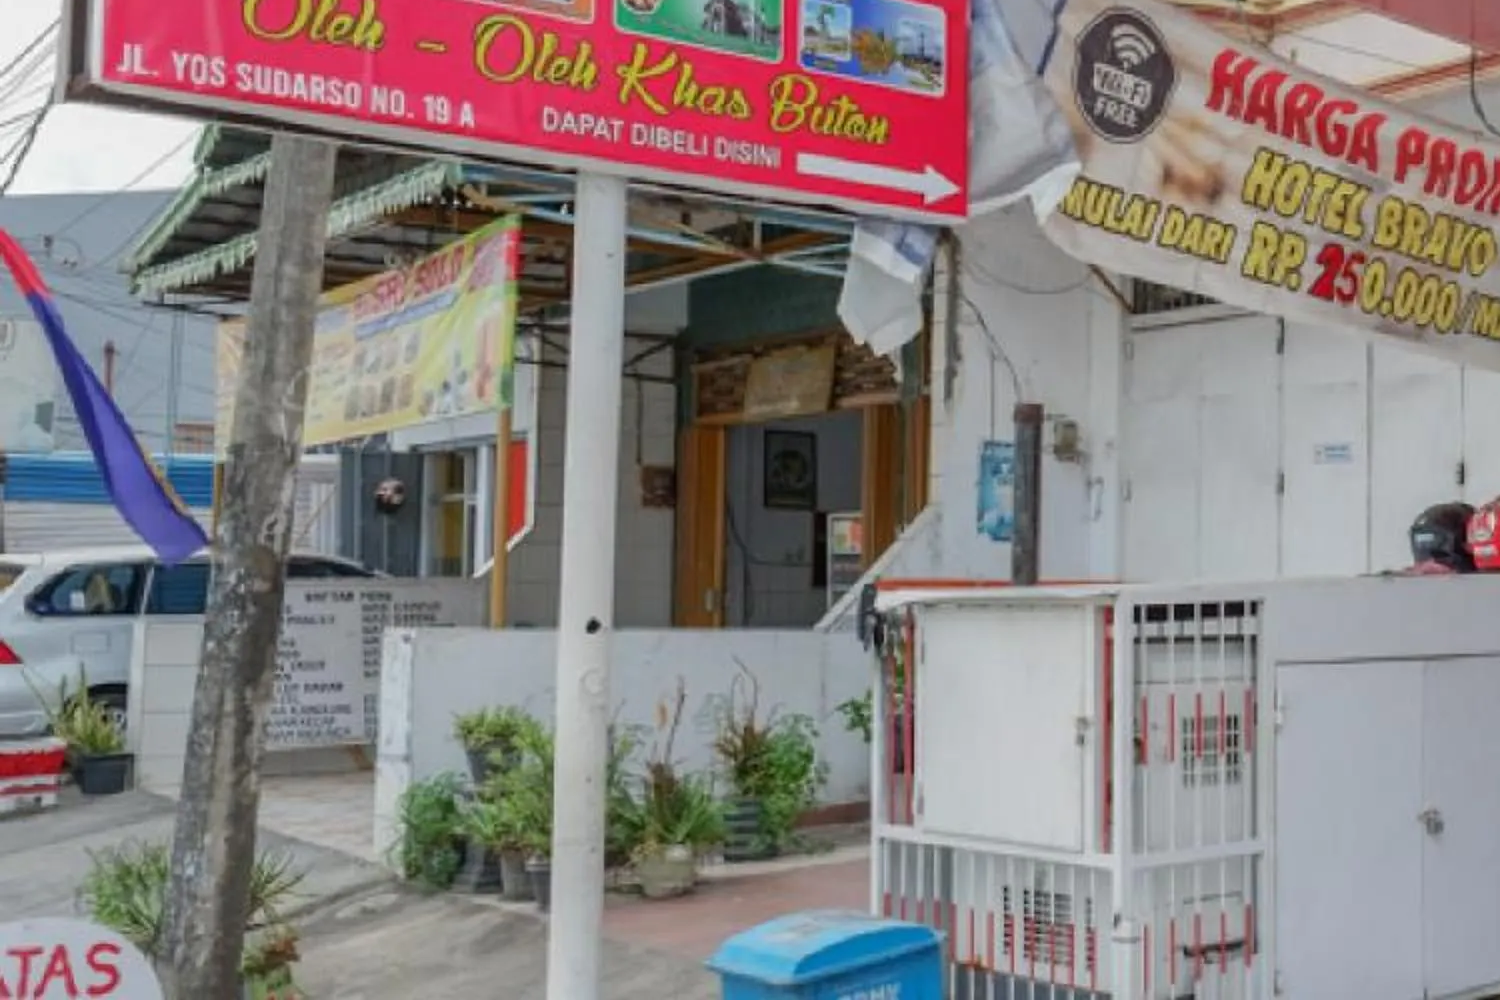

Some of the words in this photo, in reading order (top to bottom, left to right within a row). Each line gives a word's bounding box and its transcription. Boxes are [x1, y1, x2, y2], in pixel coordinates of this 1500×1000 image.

[116, 43, 159, 77] JL.
[172, 51, 227, 88] YOS
[235, 61, 363, 110] SUDARSO
[370, 85, 415, 120] NO.
[423, 95, 450, 125] 19
[459, 102, 476, 129] A
[473, 13, 599, 89] Oleh
[615, 40, 757, 121] Khas
[767, 71, 890, 145] Buton
[542, 105, 624, 144] DAPAT
[631, 121, 709, 158] DIBELI
[714, 137, 782, 169] DISINI
[1205, 48, 1389, 174] HARGA
[1157, 204, 1238, 265] DARI
[1240, 220, 1308, 292] RP.
[1308, 242, 1461, 334] 250.000
[1241, 147, 1374, 241] HOTEL
[1371, 196, 1499, 277] BRAVO
[0, 943, 122, 1000] TAS
